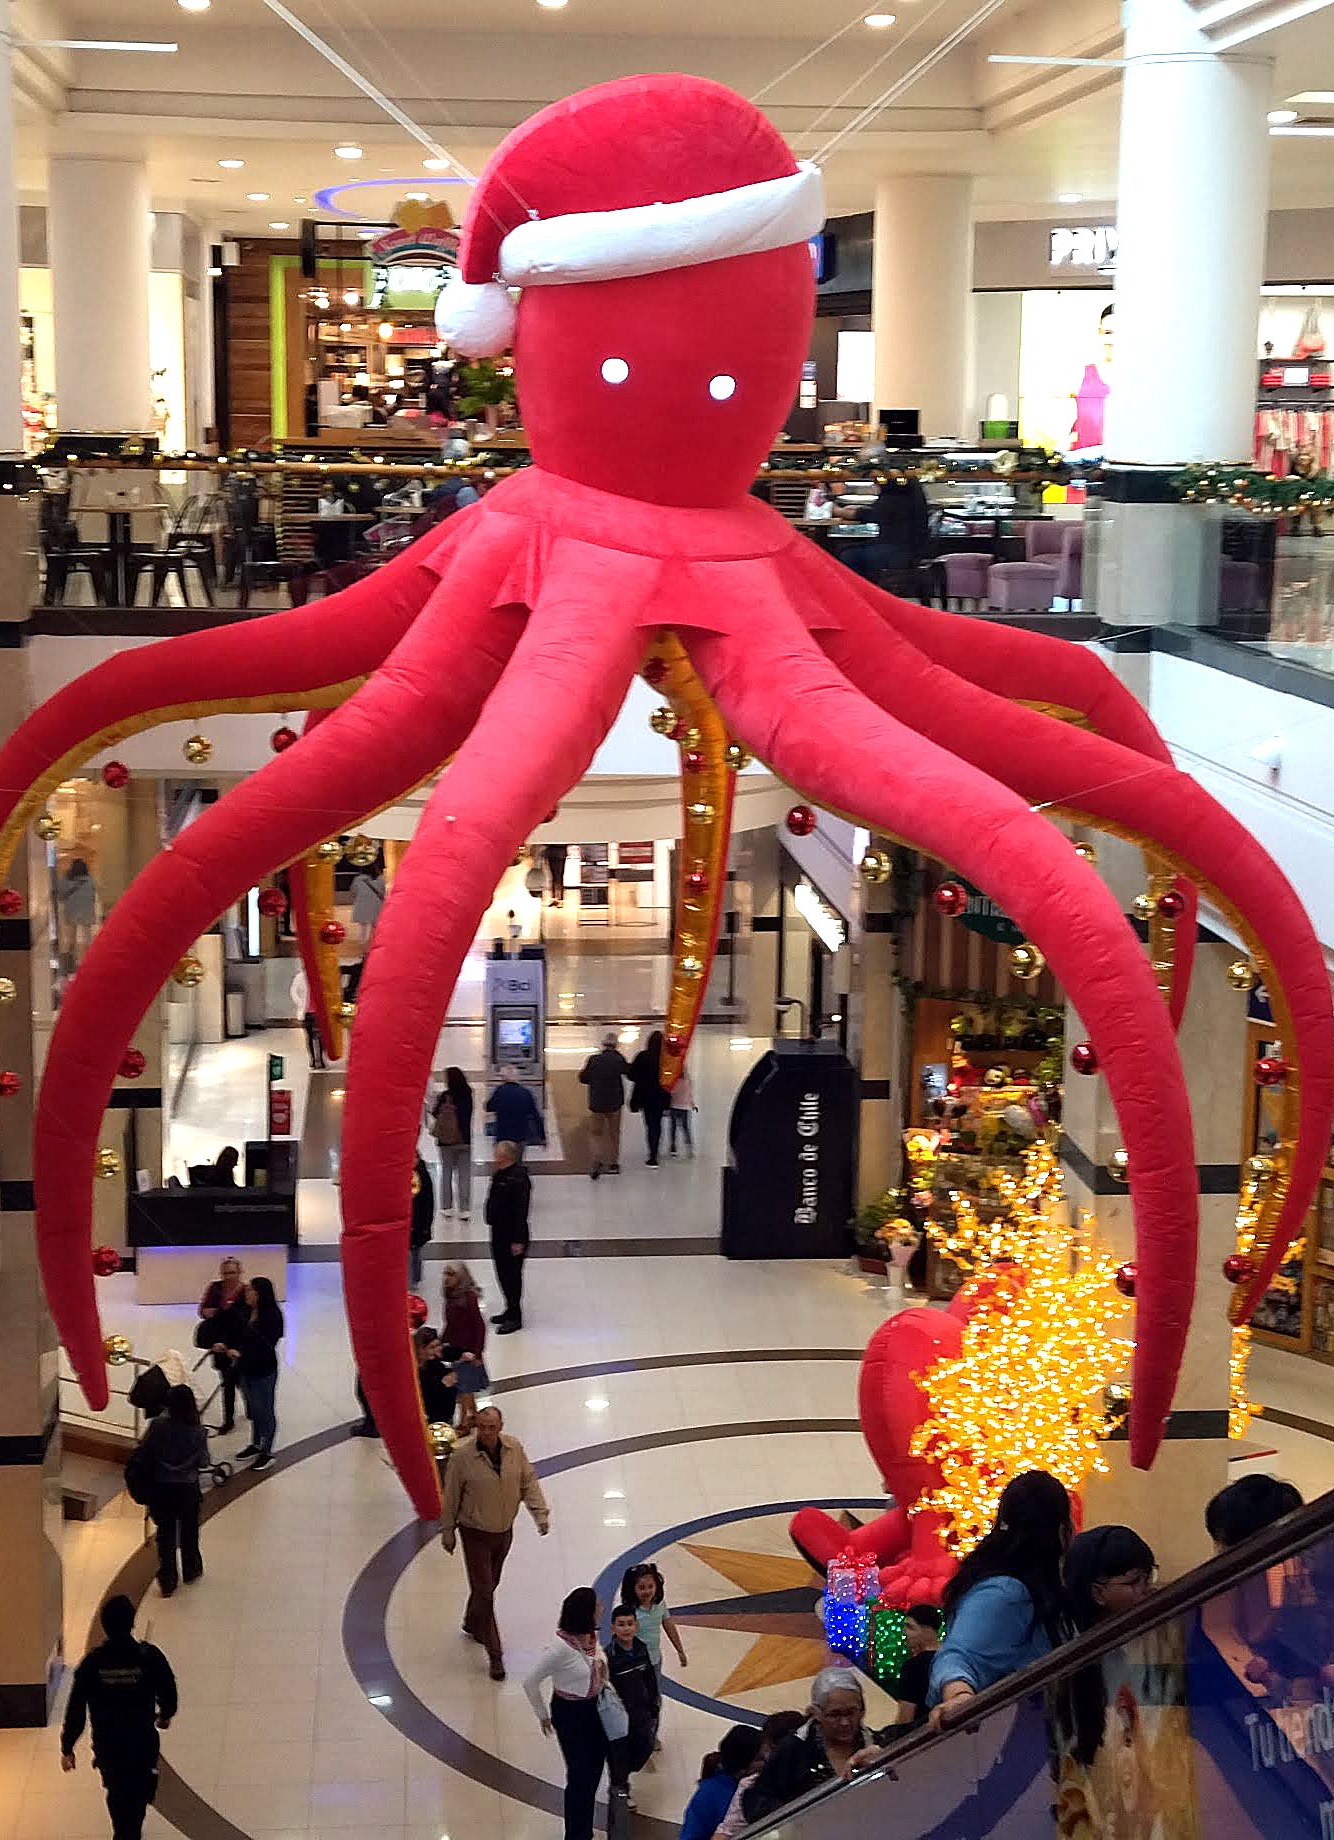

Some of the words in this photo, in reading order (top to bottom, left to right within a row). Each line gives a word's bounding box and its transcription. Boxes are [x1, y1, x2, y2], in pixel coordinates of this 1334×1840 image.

[796, 1092, 820, 1136] Chile
[798, 1144, 819, 1161] de
[794, 1168, 818, 1224] Banco
[1243, 1712, 1276, 1772] Tu
